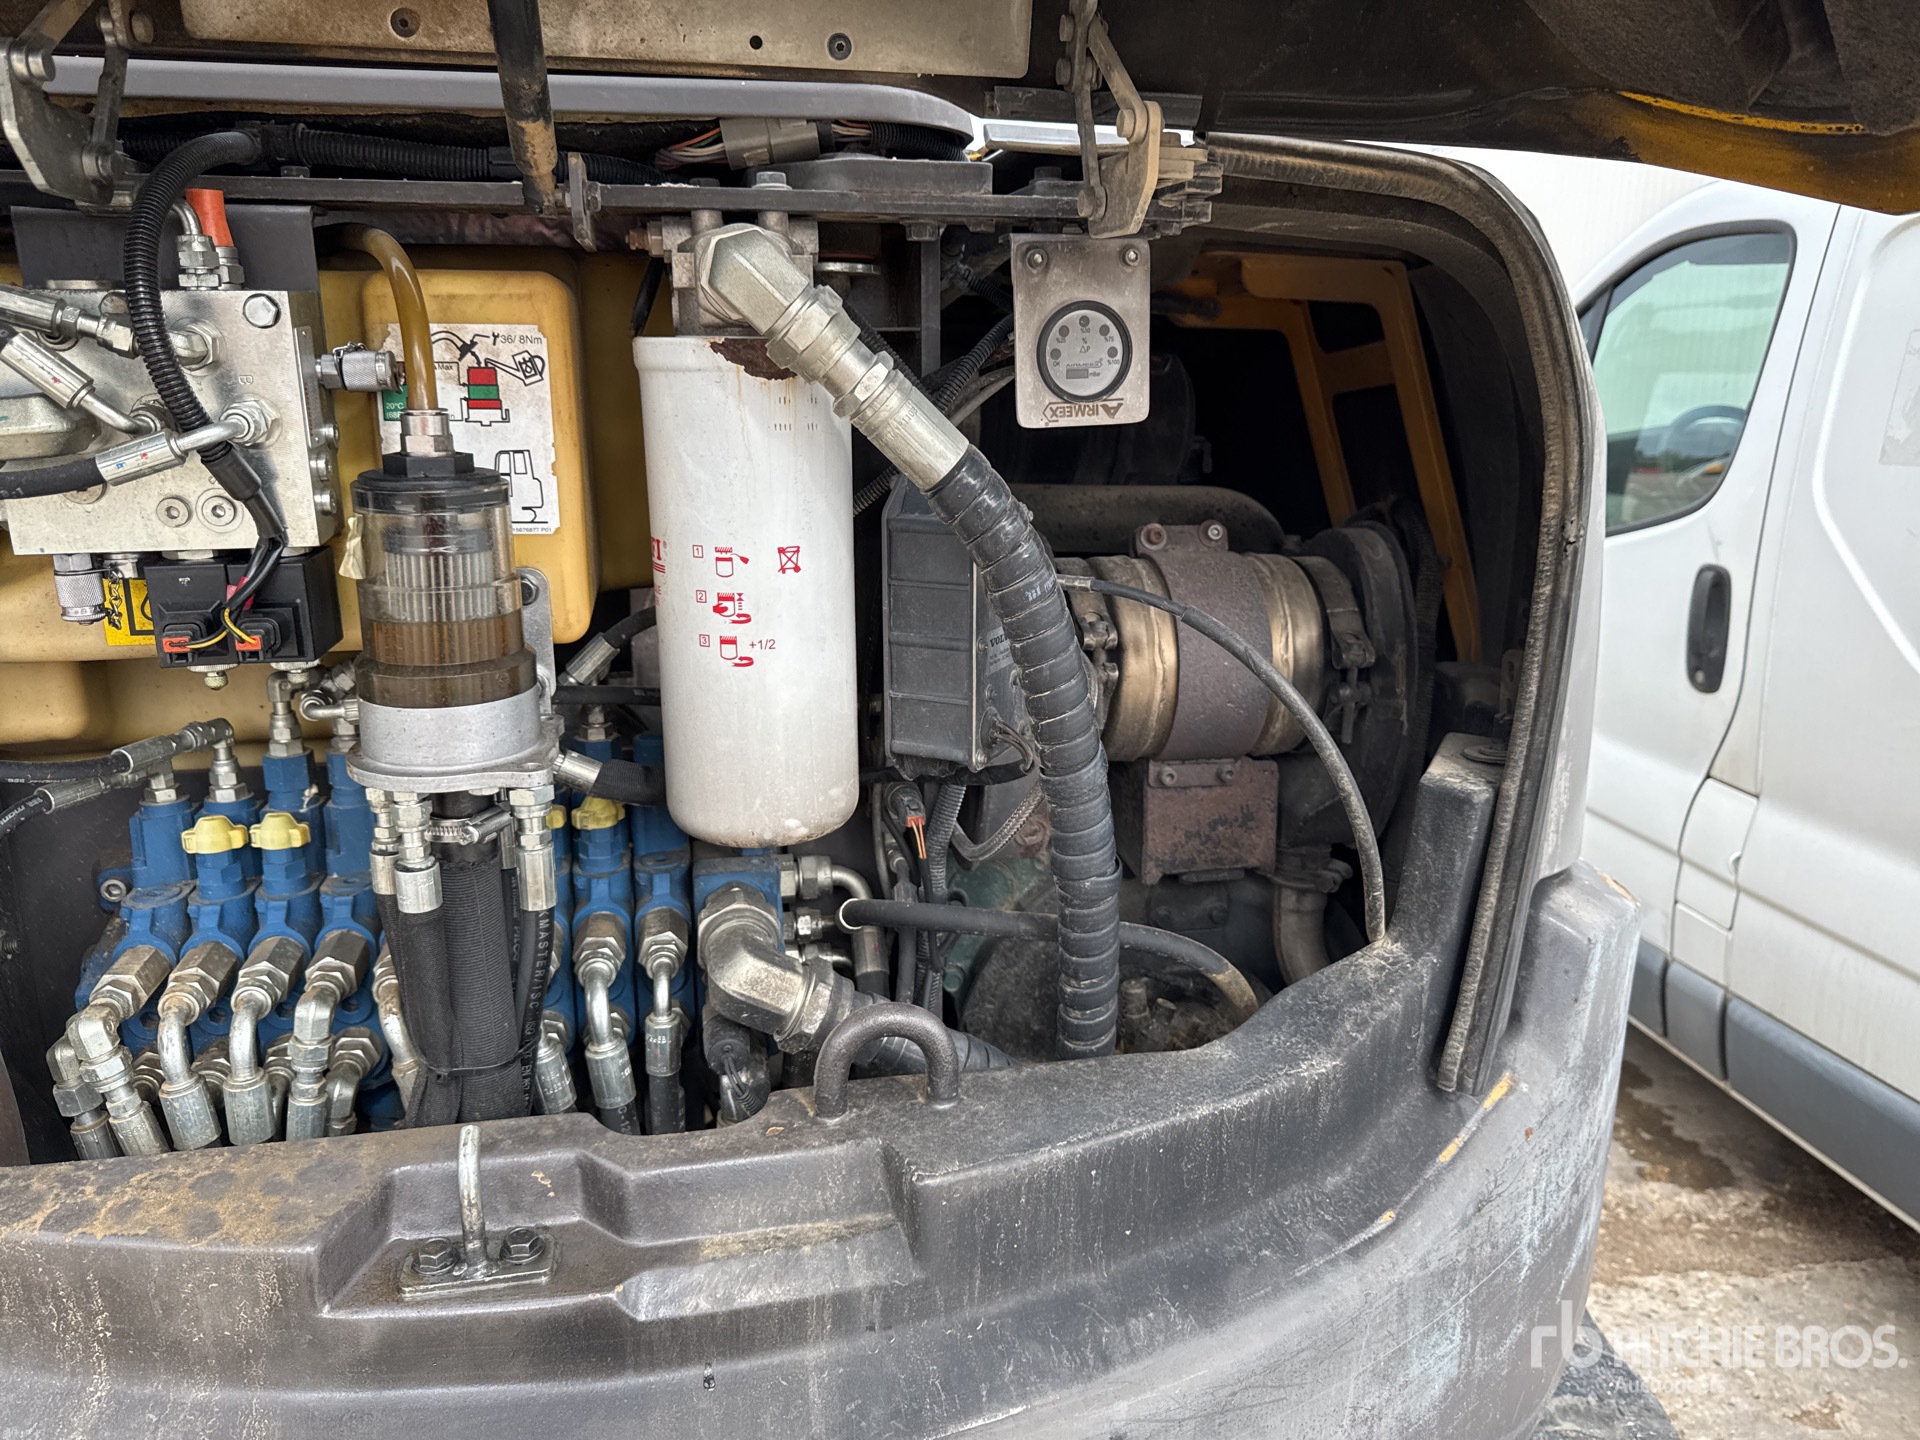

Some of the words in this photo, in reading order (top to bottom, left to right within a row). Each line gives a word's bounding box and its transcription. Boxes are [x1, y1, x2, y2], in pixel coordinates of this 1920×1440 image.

[500, 334, 517, 345] 36/
[519, 334, 543, 345] 8Nm
[749, 639, 776, 650] +1/2
